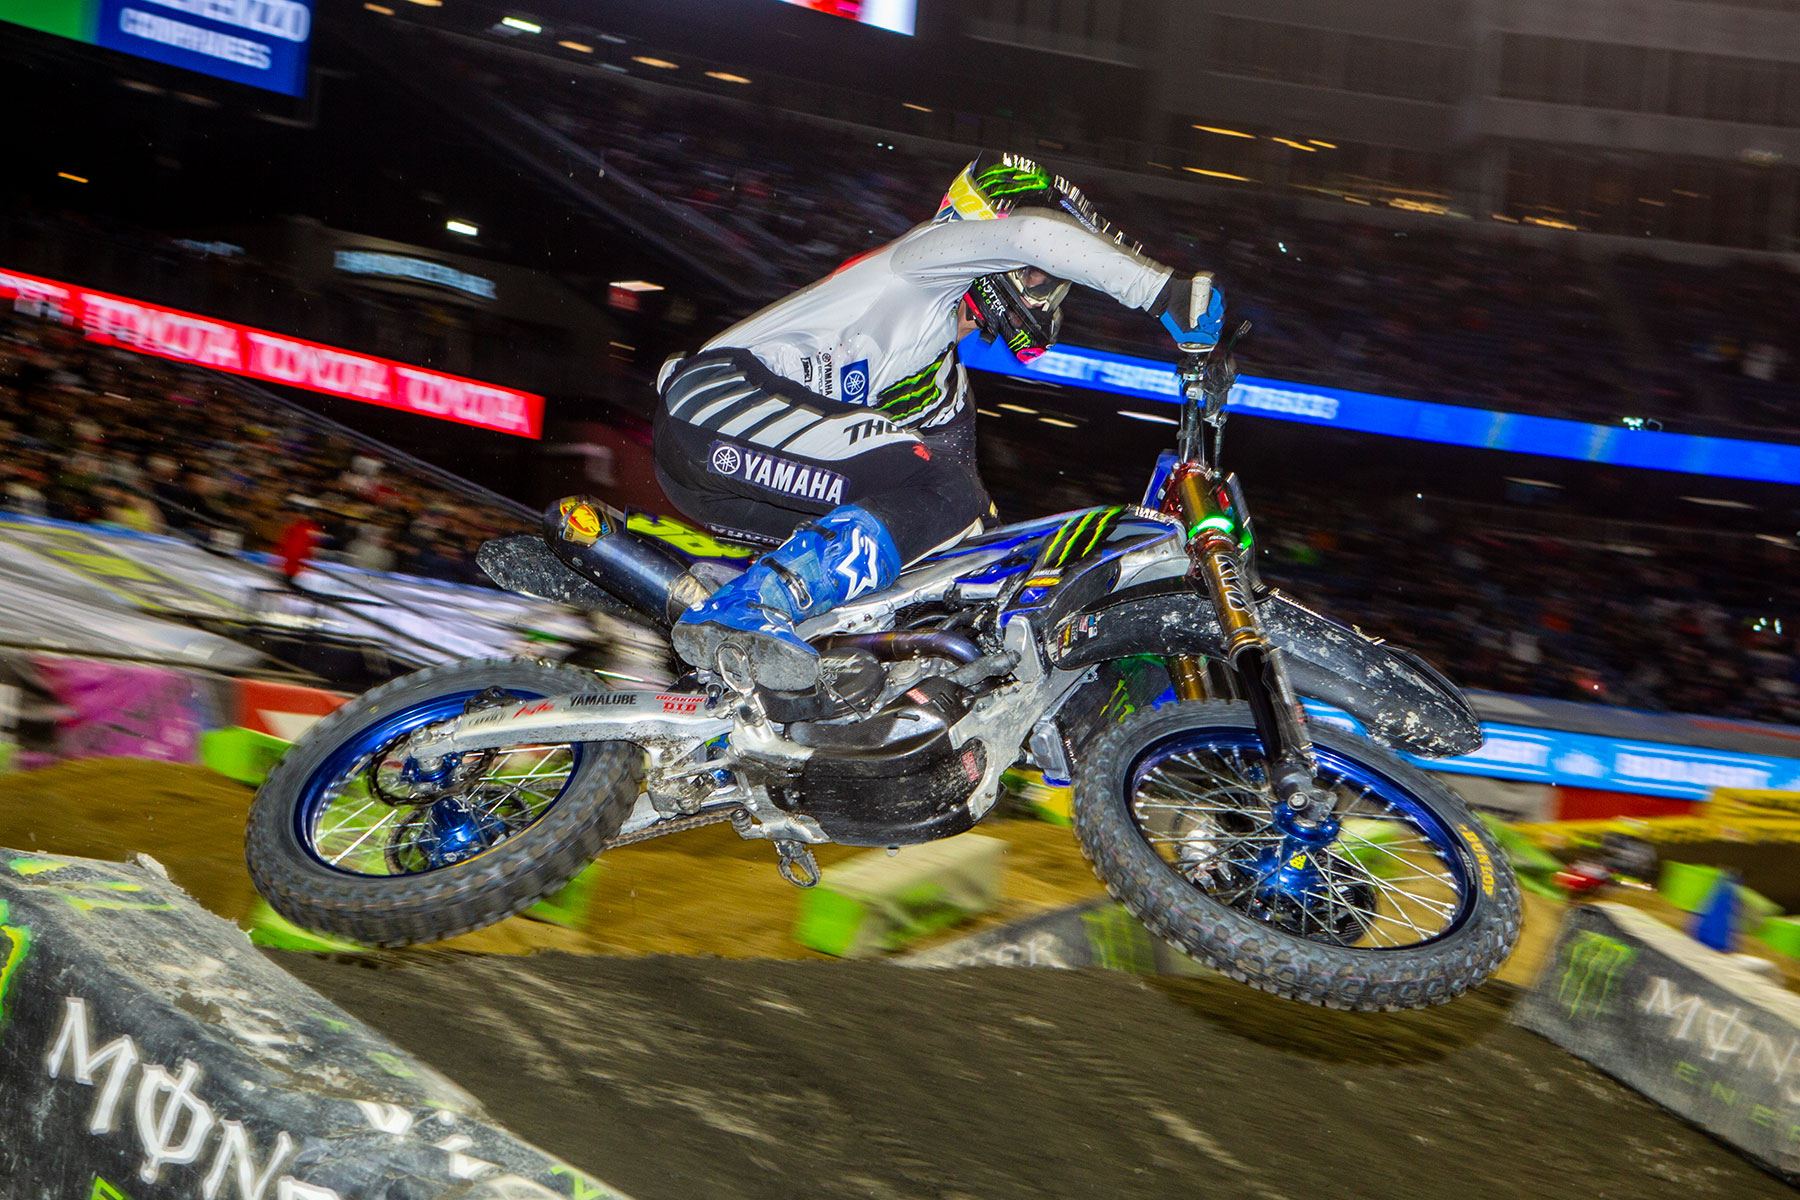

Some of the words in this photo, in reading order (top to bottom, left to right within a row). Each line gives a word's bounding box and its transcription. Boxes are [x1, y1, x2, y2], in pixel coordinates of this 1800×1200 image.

[979, 276, 1006, 316] NSTER
[824, 361, 833, 396] YAMAHA
[843, 418, 906, 446] THO
[744, 453, 844, 506] YAMAHA
[570, 694, 637, 707] YAMALUBE
[663, 701, 697, 712] DID
[1460, 831, 1495, 896] DUNLOP
[47, 996, 343, 1200] MON
